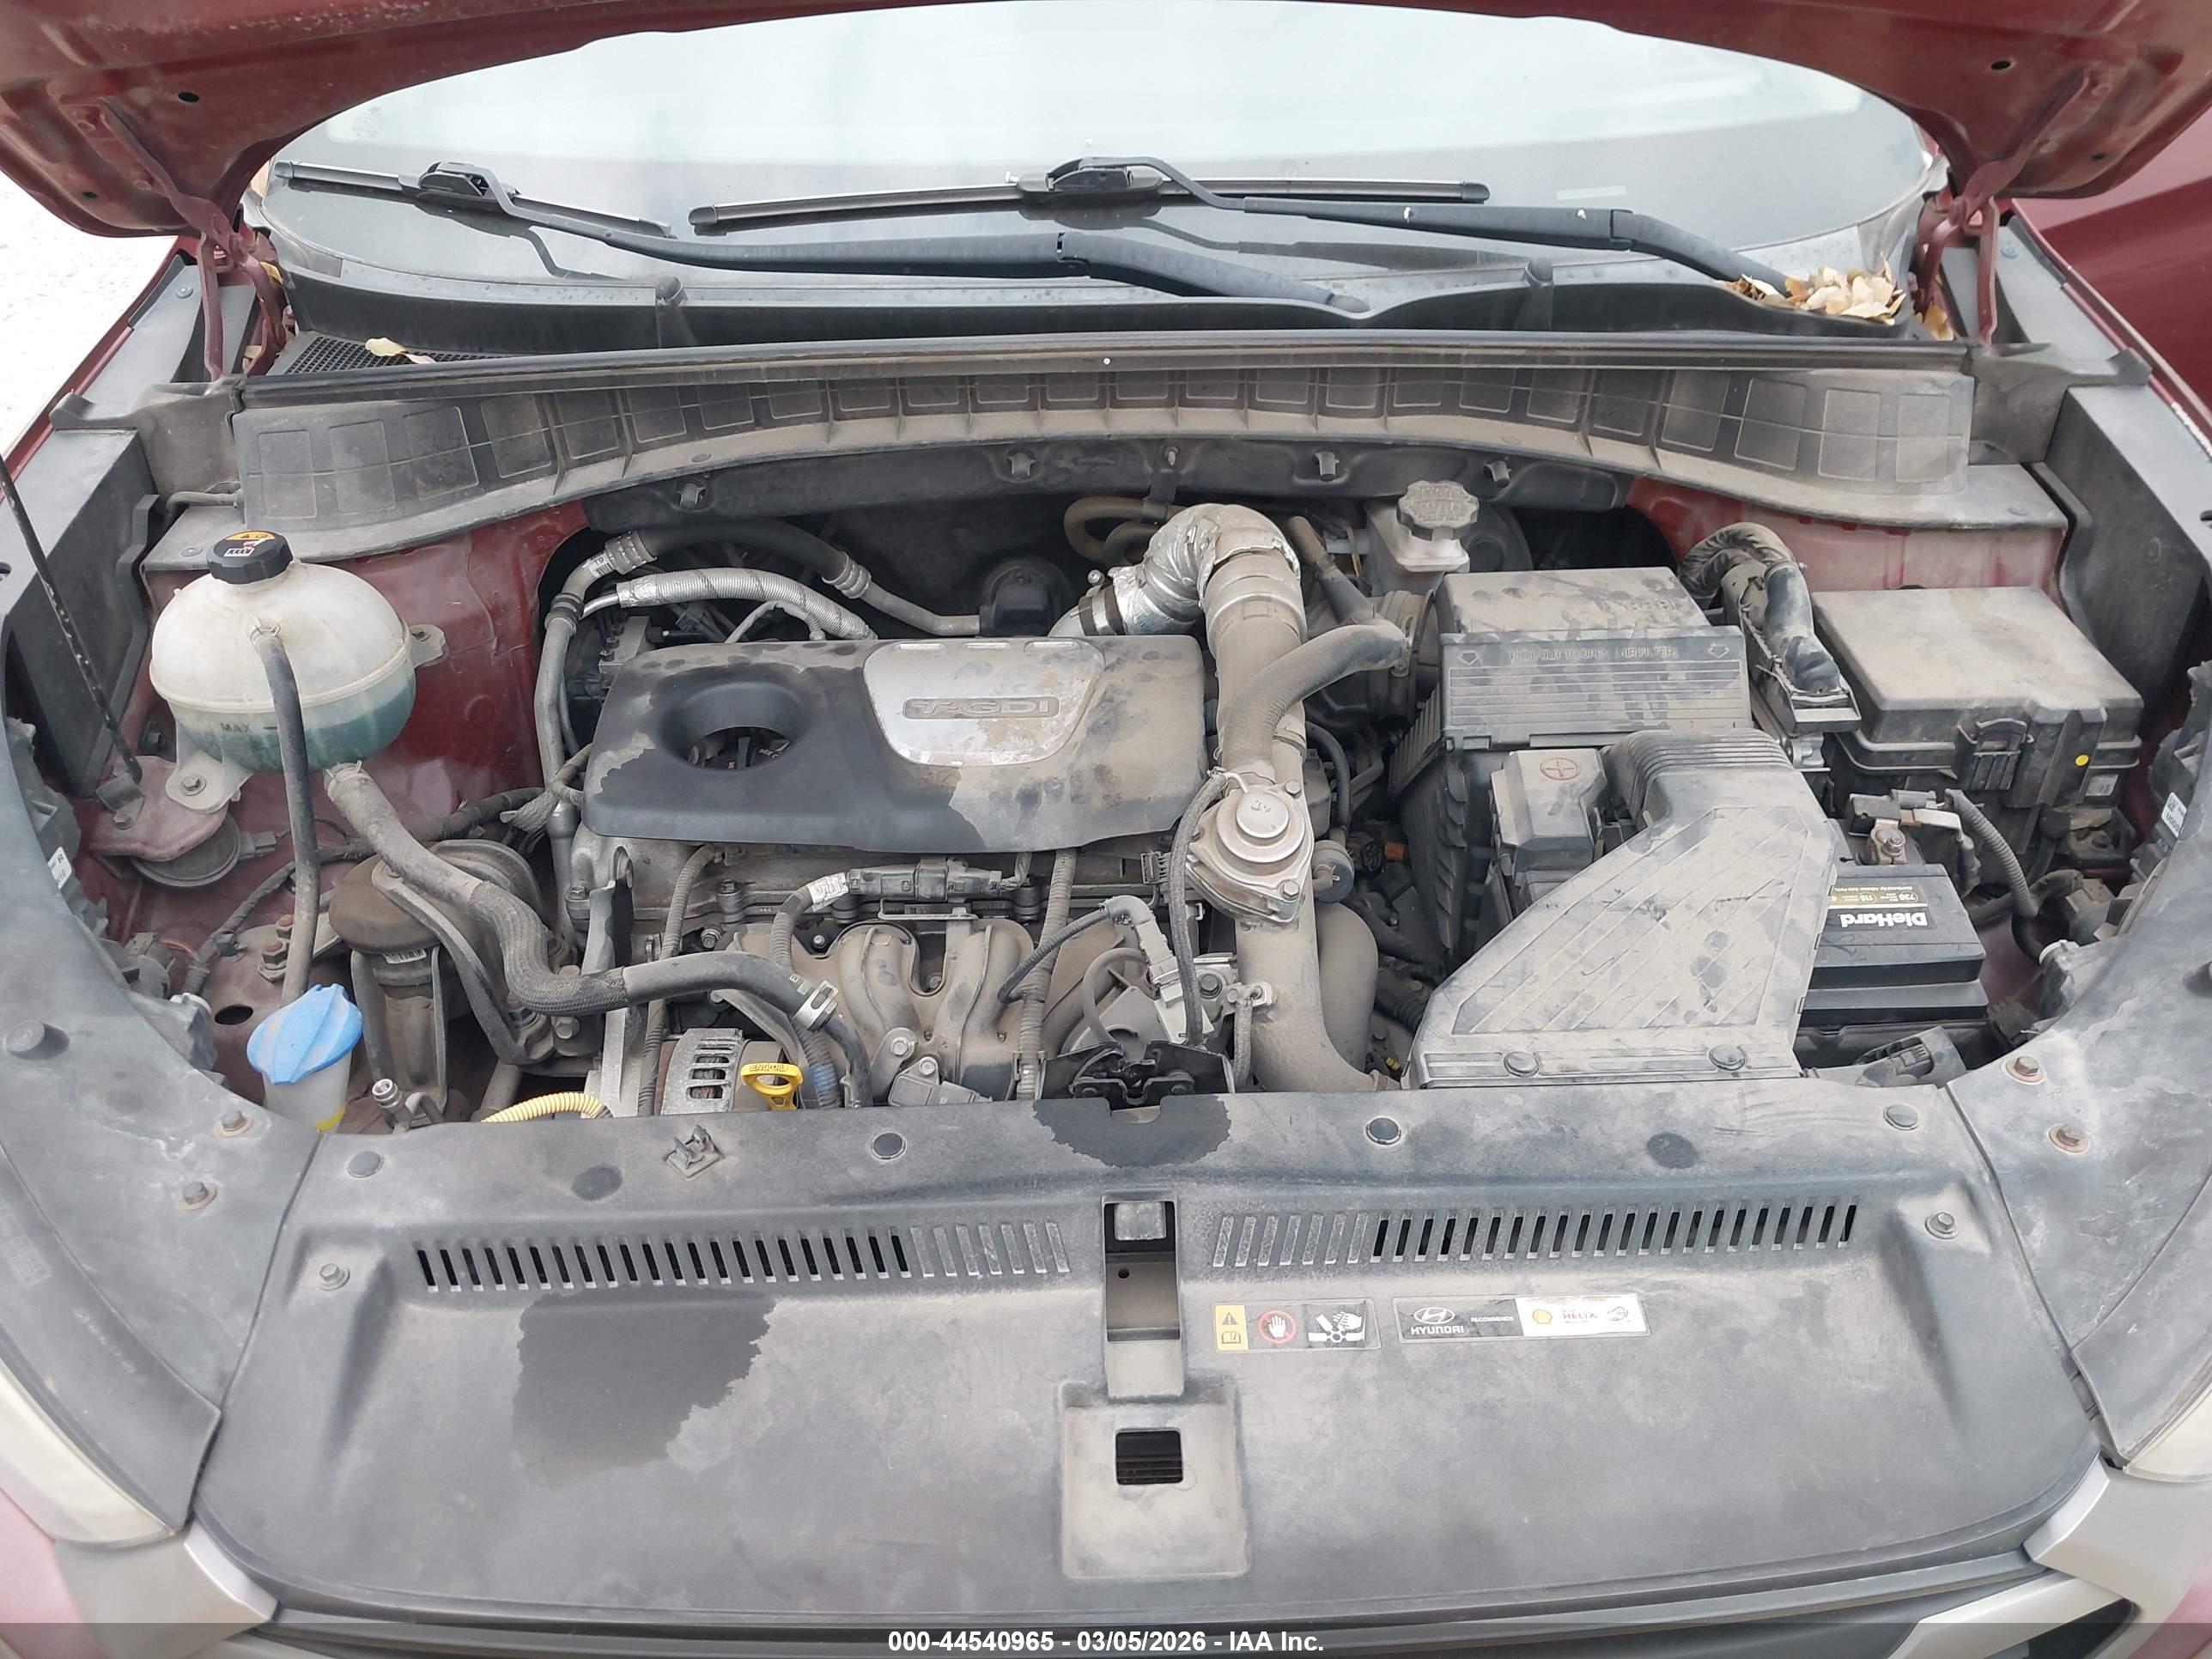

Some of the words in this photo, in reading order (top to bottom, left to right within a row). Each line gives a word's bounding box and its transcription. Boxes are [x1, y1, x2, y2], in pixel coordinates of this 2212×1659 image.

[220, 722, 251, 733] MAX
[1839, 912, 1929, 928] DieHard
[1410, 1325, 1465, 1335] HYUNDAI
